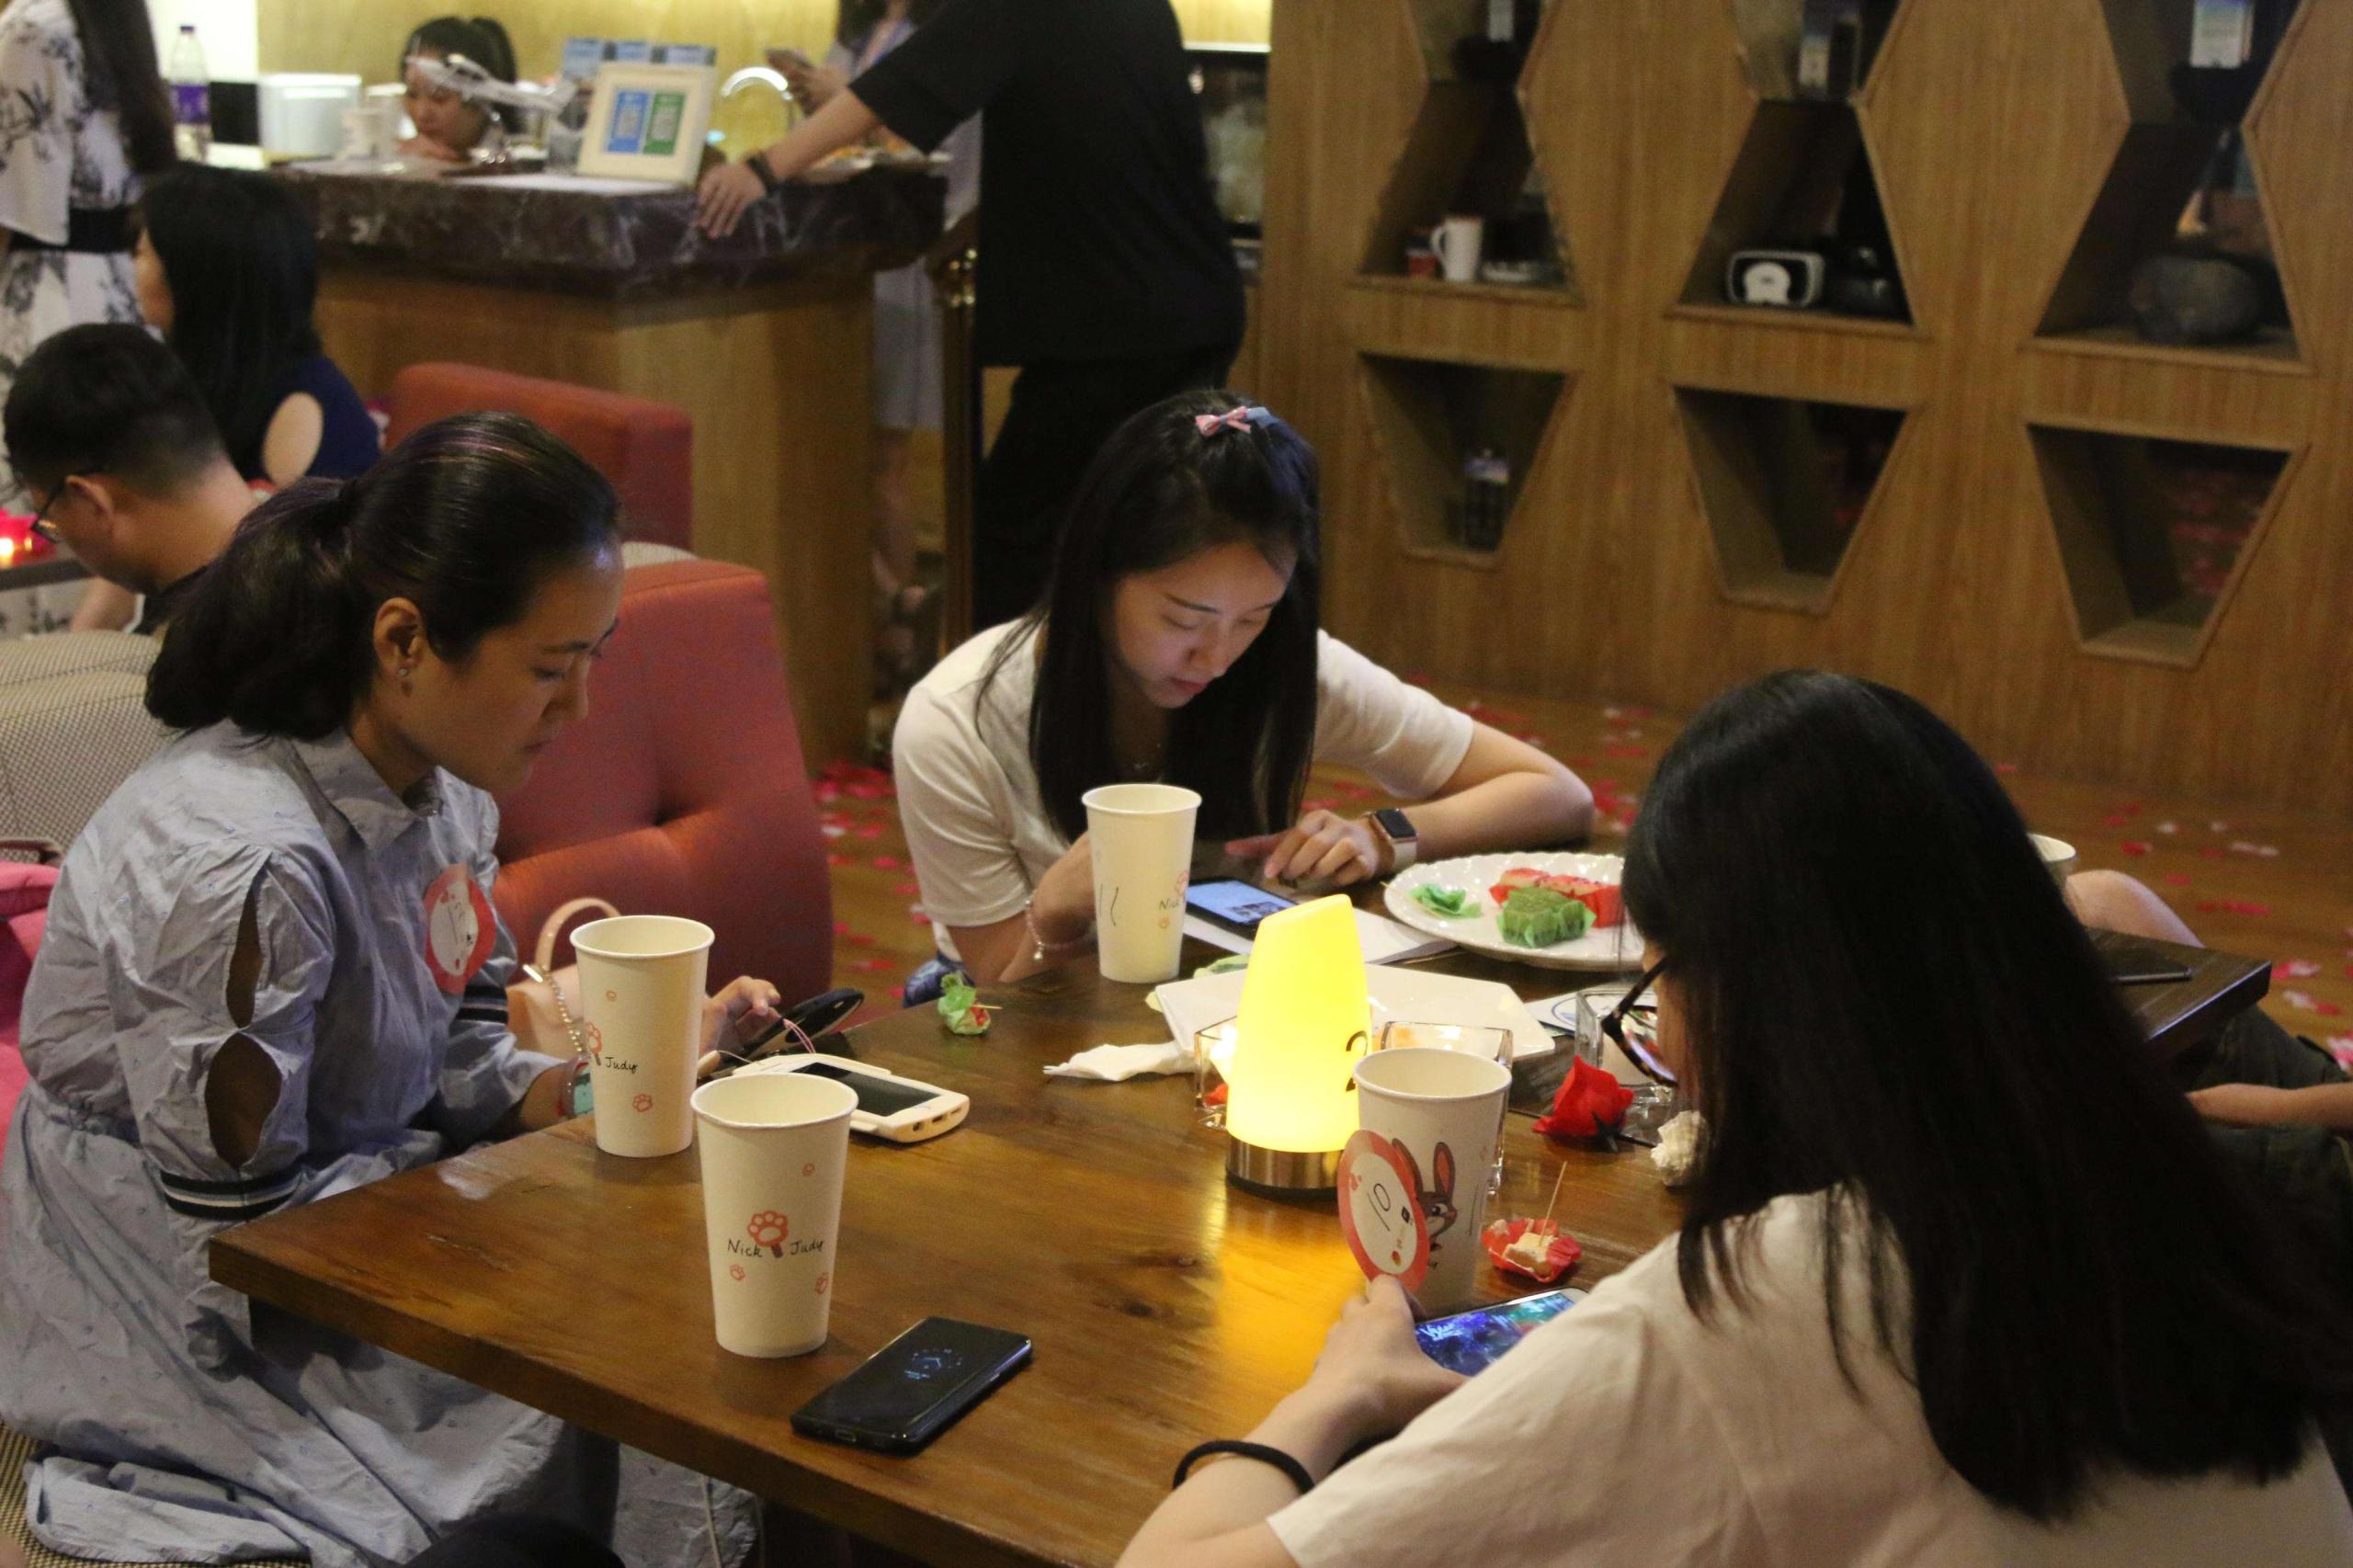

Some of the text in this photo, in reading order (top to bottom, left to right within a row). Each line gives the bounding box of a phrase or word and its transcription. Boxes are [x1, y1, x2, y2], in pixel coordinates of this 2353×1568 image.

[605, 1056, 639, 1074] Judy
[1368, 1183, 1391, 1232] 10
[728, 1239, 824, 1257] Nick Judy
